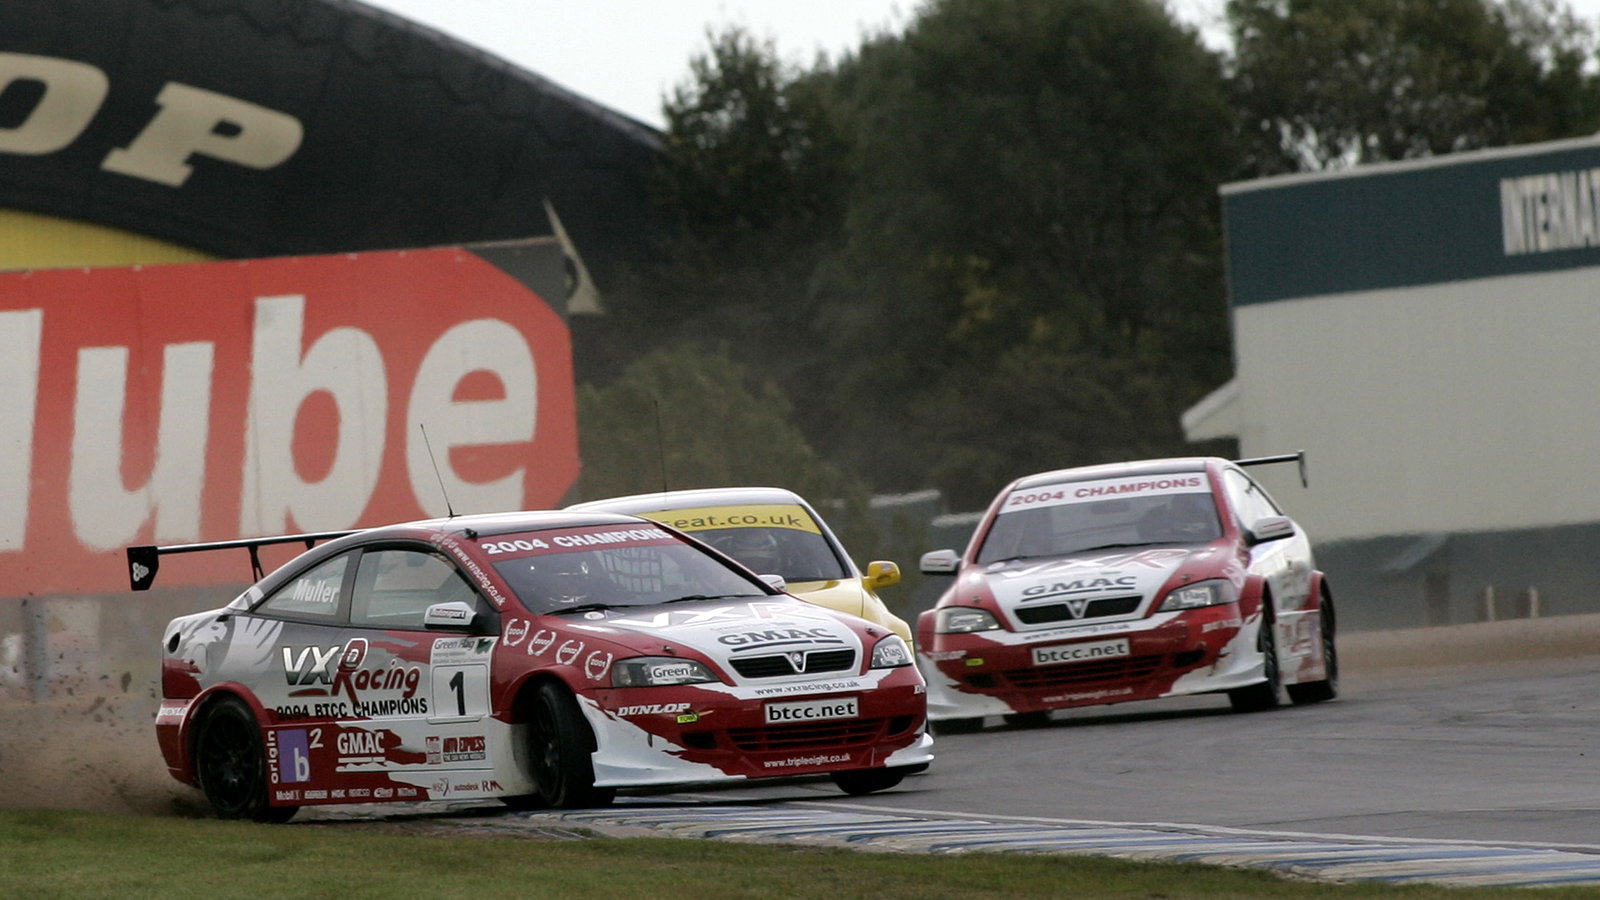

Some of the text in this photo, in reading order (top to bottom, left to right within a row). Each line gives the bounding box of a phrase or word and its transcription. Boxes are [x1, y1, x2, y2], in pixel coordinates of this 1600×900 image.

[1010, 477, 1200, 505] 2004 CHAMPIONS
[481, 528, 673, 554] 2004 CHAMPIONS
[292, 579, 340, 603] Muller
[1022, 576, 1136, 596] GMAC
[434, 639, 458, 650] Green
[718, 628, 837, 646] GMAC
[1037, 643, 1125, 663] btcc.net
[653, 666, 690, 678] Green
[449, 671, 466, 716] 1
[755, 681, 860, 696] www.vxracing.co.uk
[315, 702, 348, 718] BTCC
[352, 697, 428, 717] CHAMPIONS
[617, 703, 691, 716] DUNLOP
[769, 702, 856, 721] btcc.net
[309, 728, 324, 749] 2
[337, 731, 385, 754] GMAC
[267, 731, 279, 784] origin
[294, 747, 310, 782] b
